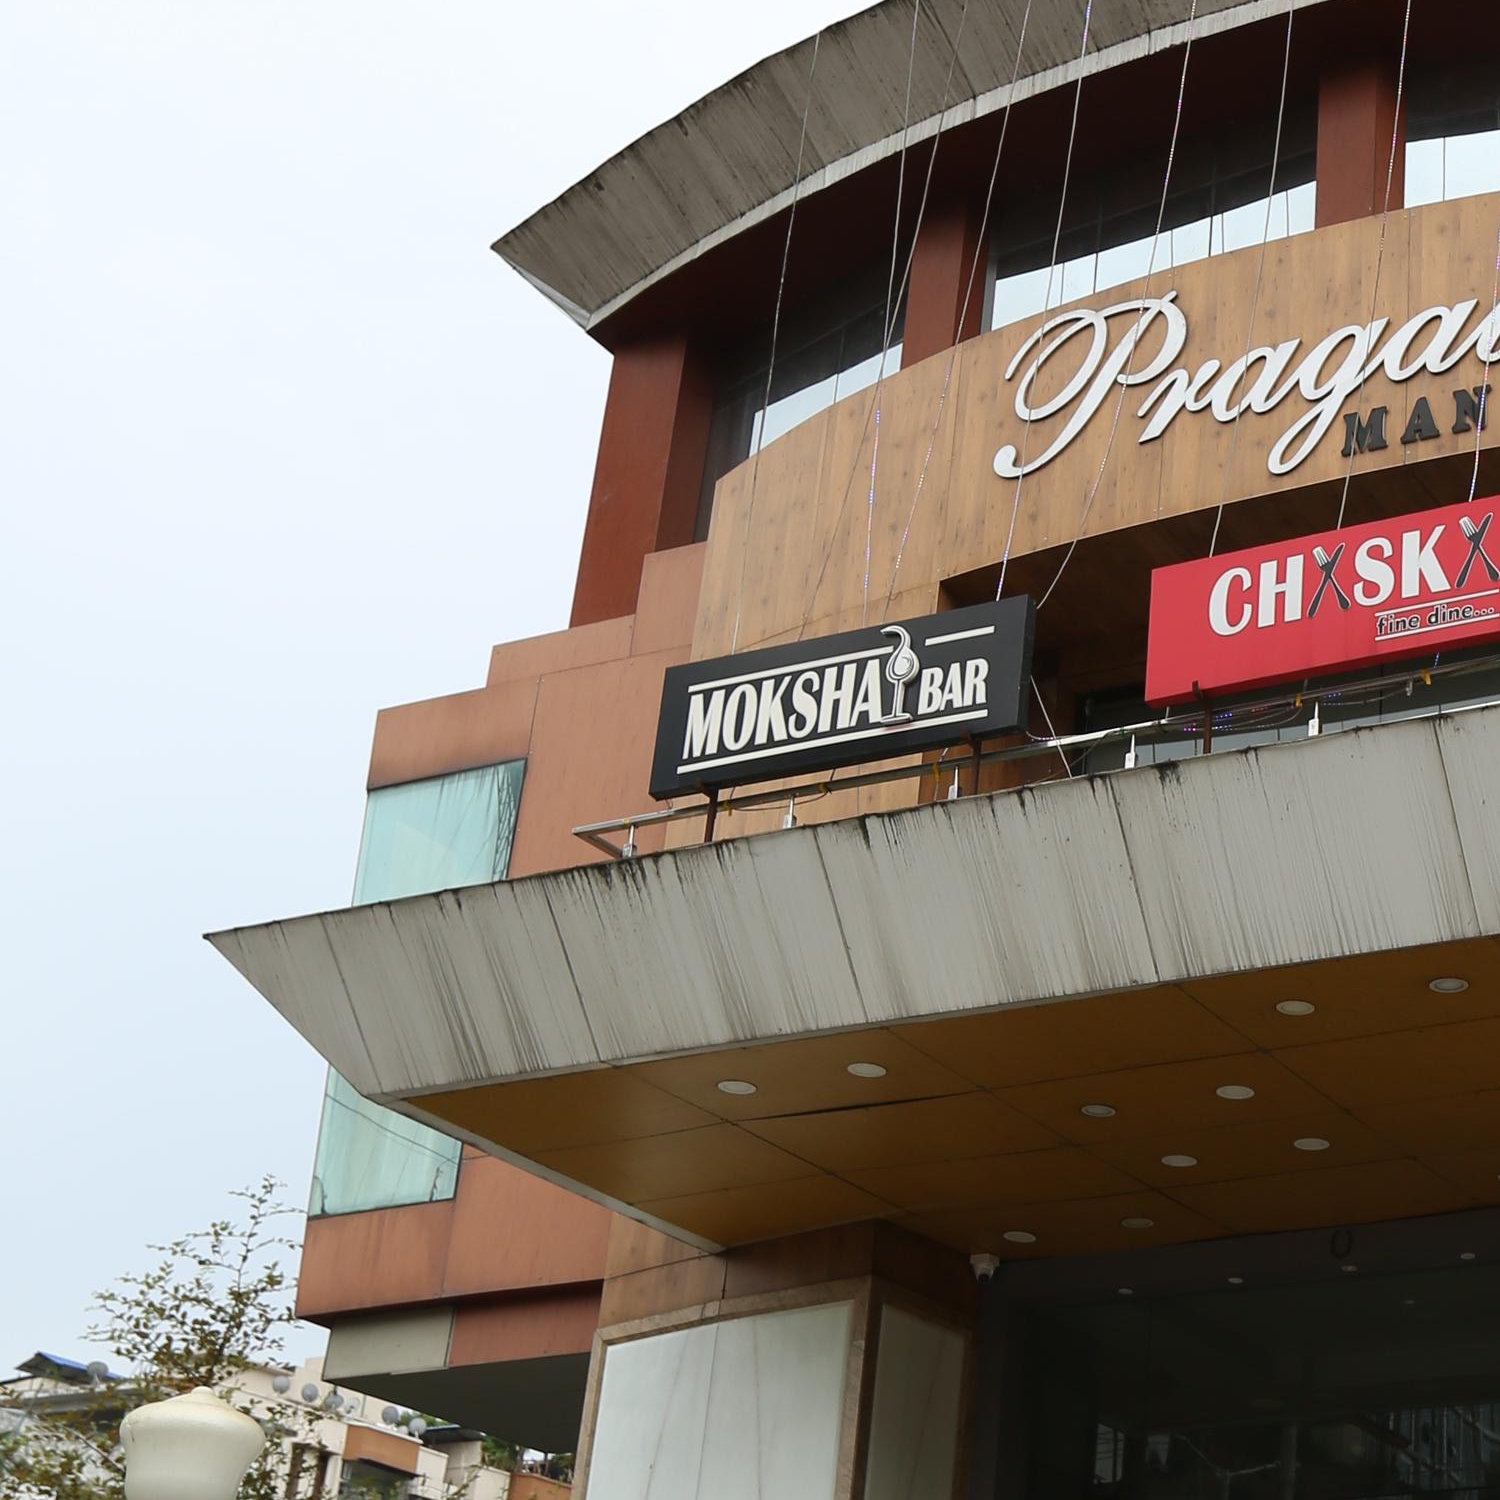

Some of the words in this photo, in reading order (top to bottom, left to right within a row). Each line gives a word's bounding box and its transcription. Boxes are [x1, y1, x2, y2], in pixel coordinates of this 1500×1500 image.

[1376, 613, 1420, 635] fine
[682, 657, 884, 760] MOKSHA
[917, 657, 990, 716] BAR
